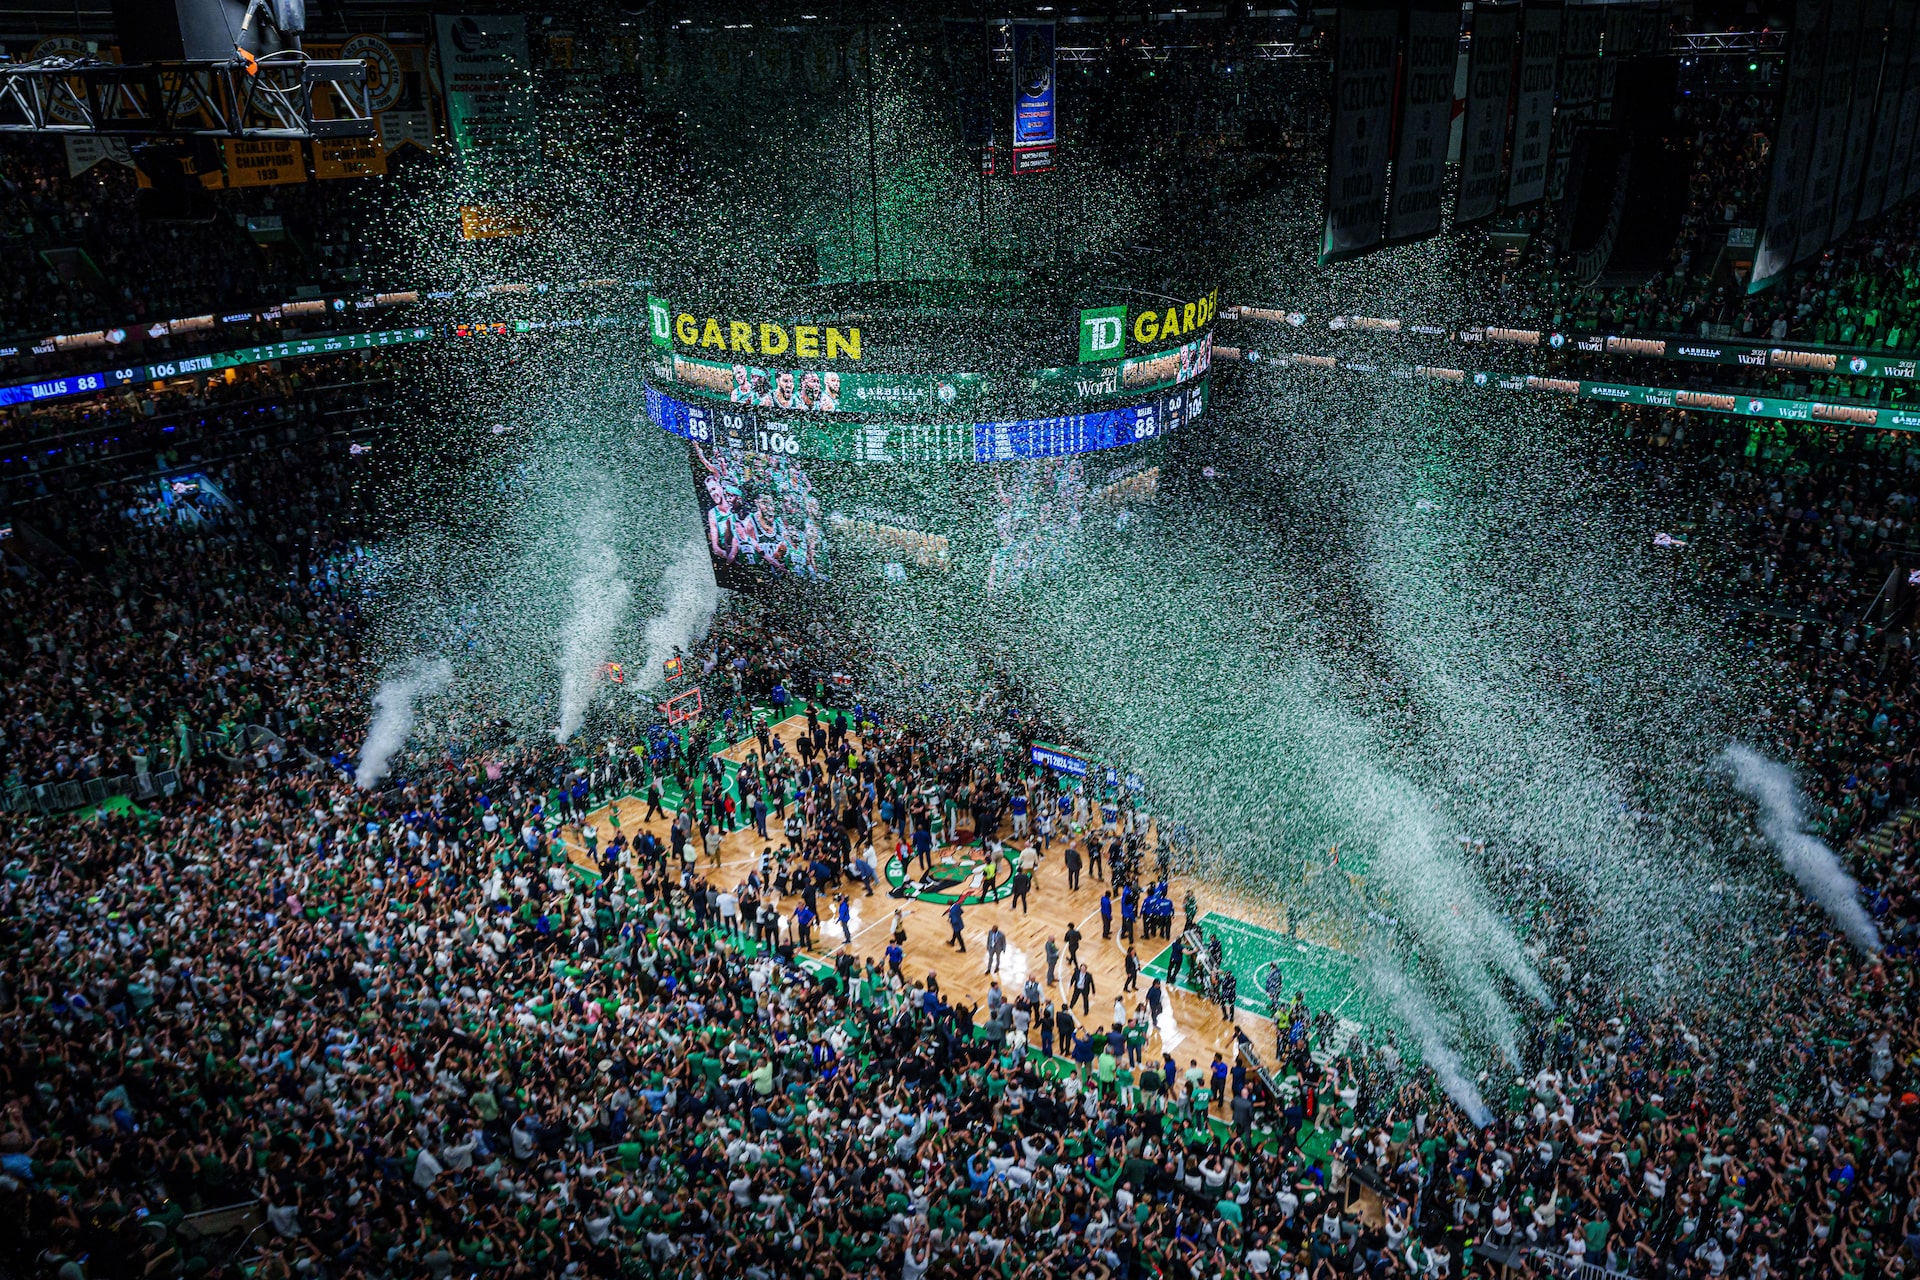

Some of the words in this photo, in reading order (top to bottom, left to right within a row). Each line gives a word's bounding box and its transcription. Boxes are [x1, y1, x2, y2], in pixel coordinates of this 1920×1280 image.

[1343, 36, 1392, 70] BOSTON
[1411, 36, 1455, 67] BOSTON
[1526, 30, 1558, 58] BOSTON
[1523, 63, 1553, 92] CELTICS
[1342, 74, 1388, 111] CELTICS
[1410, 73, 1449, 105] CELTICS
[235, 143, 273, 154] STANLEY
[236, 154, 294, 169] CHAMPIONS
[257, 169, 278, 181] 1939
[1342, 173, 1373, 200] WORLD
[1331, 198, 1382, 229] CHAMPIONS
[355, 300, 375, 309] World
[262, 311, 282, 321] World
[1219, 311, 1238, 320] World
[649, 304, 671, 338] TD
[675, 313, 861, 360] GARDEN
[1085, 316, 1122, 351] TD
[1459, 332, 1482, 343] World
[1486, 327, 1540, 346] CHAMPIONS
[32, 344, 55, 354] World
[324, 342, 342, 350] 13/39
[1578, 341, 1603, 352] World
[1606, 337, 1666, 357] CHAMPIONS
[149, 364, 175, 378] 106
[179, 357, 213, 373] BOSTON
[1738, 354, 1766, 366] World
[1770, 351, 1837, 371] CHAMPIONS
[116, 368, 133, 379] 0.0
[1884, 366, 1915, 378] World
[32, 381, 67, 398] DALLAS
[78, 376, 97, 390] 88
[1075, 377, 1117, 397] World
[1499, 380, 1523, 390] World
[1527, 375, 1580, 394] CHAMPIONS
[1169, 397, 1182, 411] 0.0
[1646, 395, 1671, 405] World
[1676, 391, 1736, 411] CHAMPIONS
[723, 415, 743, 430] 0.0
[1779, 408, 1807, 419] World
[1812, 403, 1878, 424] CHAMPIONS
[689, 419, 709, 440] 88
[1135, 418, 1155, 438] 88
[759, 431, 800, 455] 106
